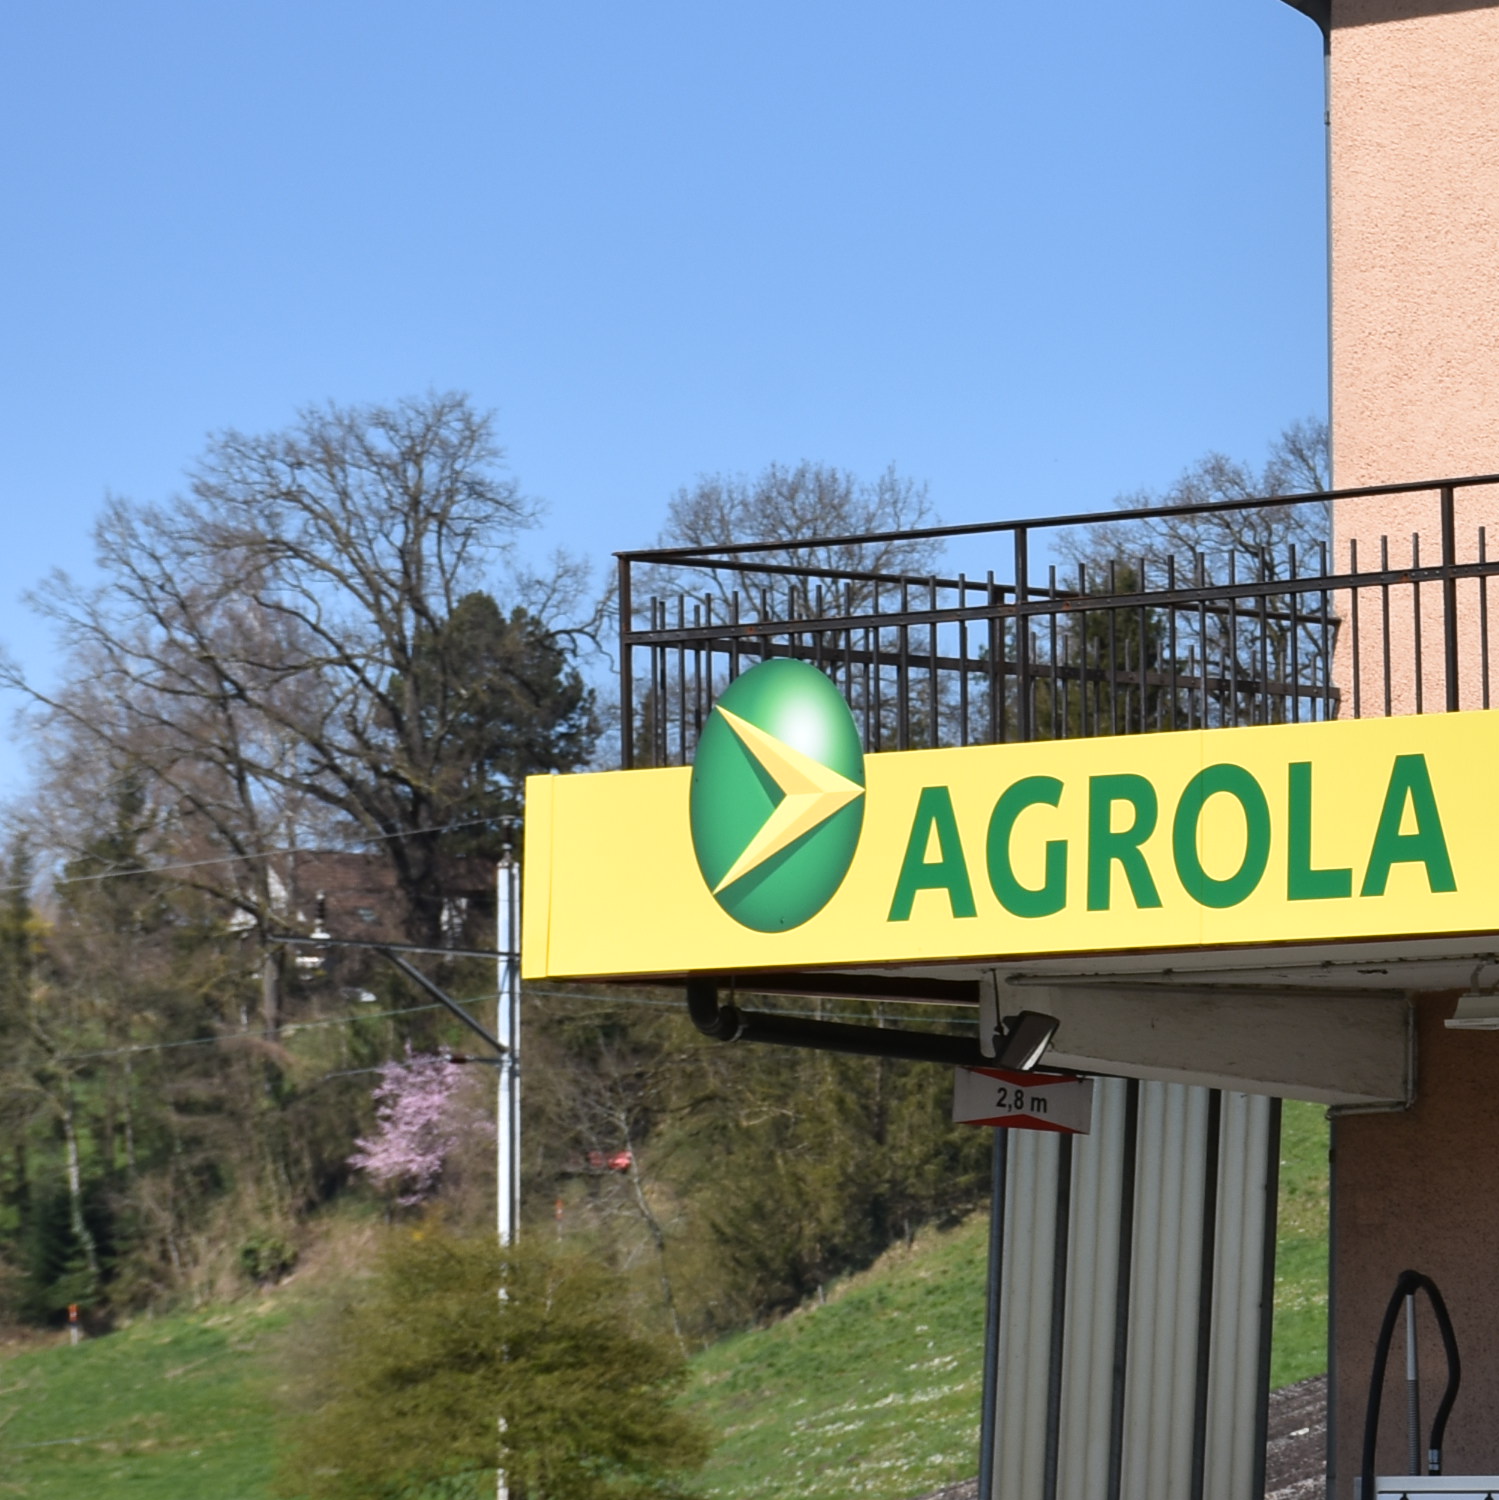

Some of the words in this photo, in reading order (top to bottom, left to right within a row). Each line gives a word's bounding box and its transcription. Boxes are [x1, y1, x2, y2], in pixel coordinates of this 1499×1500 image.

[887, 753, 1457, 922] AGROLA
[996, 1087, 1024, 1112] 2,8
[1030, 1096, 1047, 1113] m
